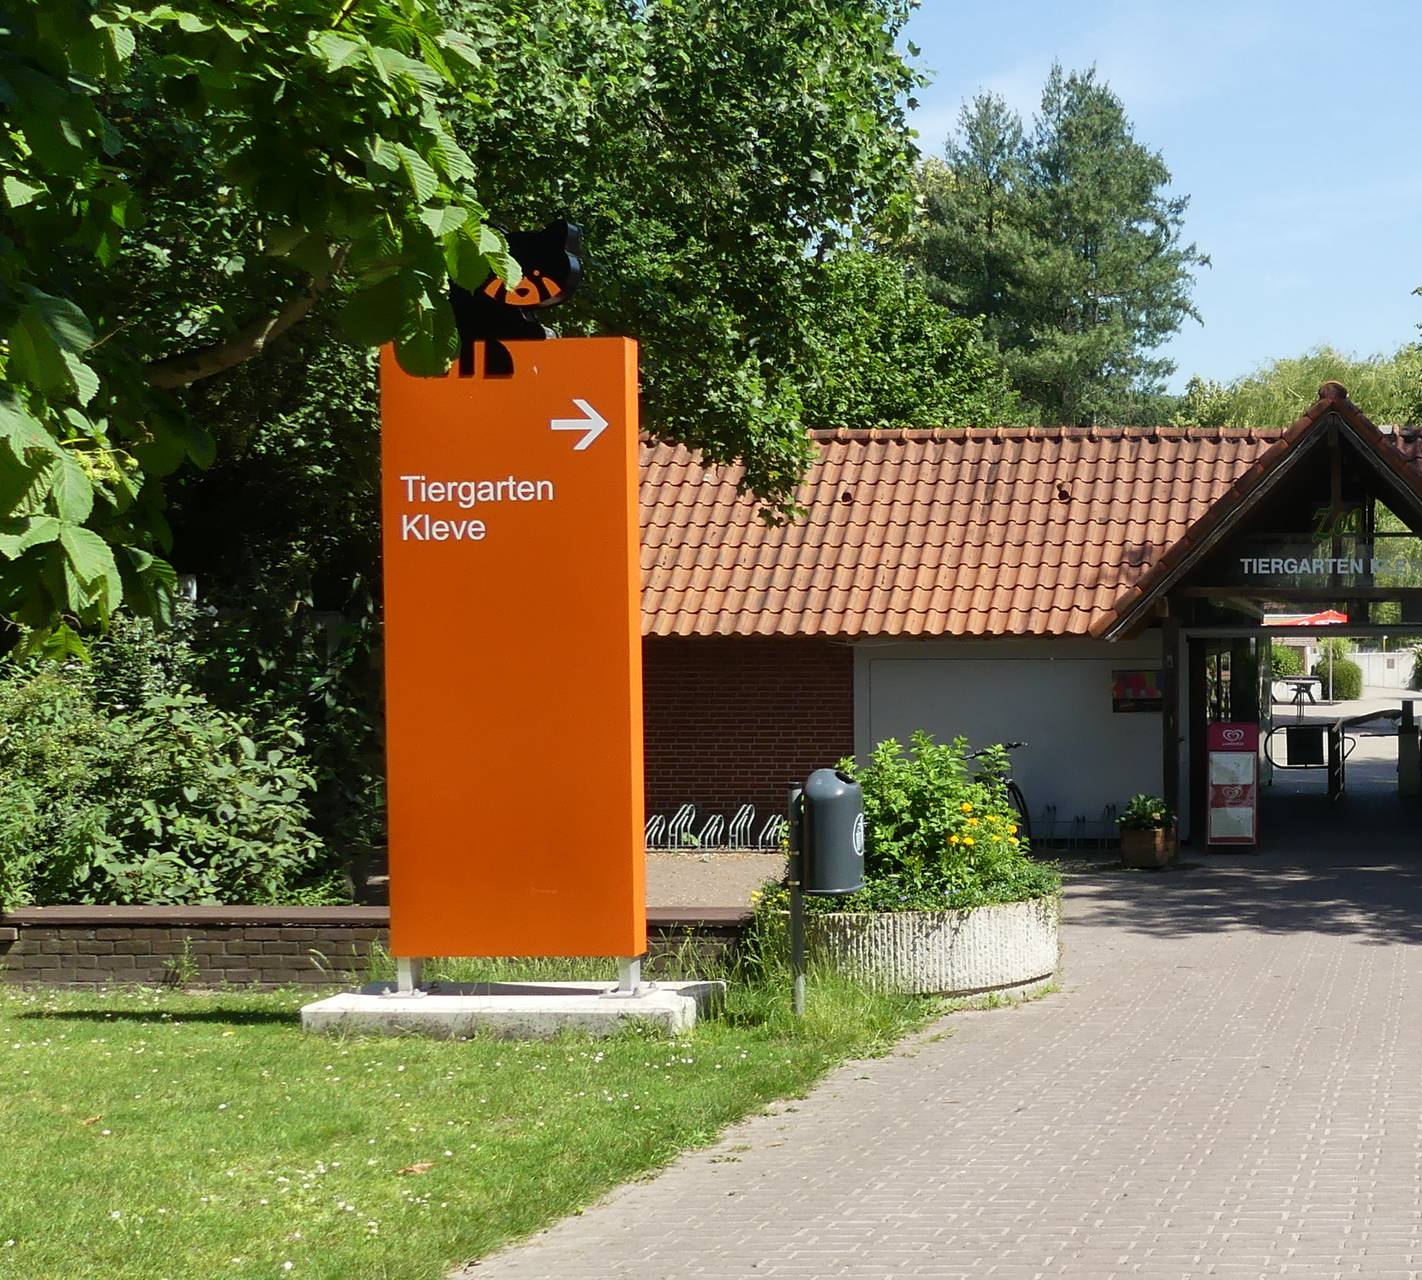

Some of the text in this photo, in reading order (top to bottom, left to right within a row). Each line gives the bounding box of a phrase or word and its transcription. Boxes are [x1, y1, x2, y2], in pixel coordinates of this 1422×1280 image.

[400, 475, 554, 509] Tiergarten
[402, 514, 486, 541] Kleve
[1240, 558, 1363, 574] TIERGARTEN
